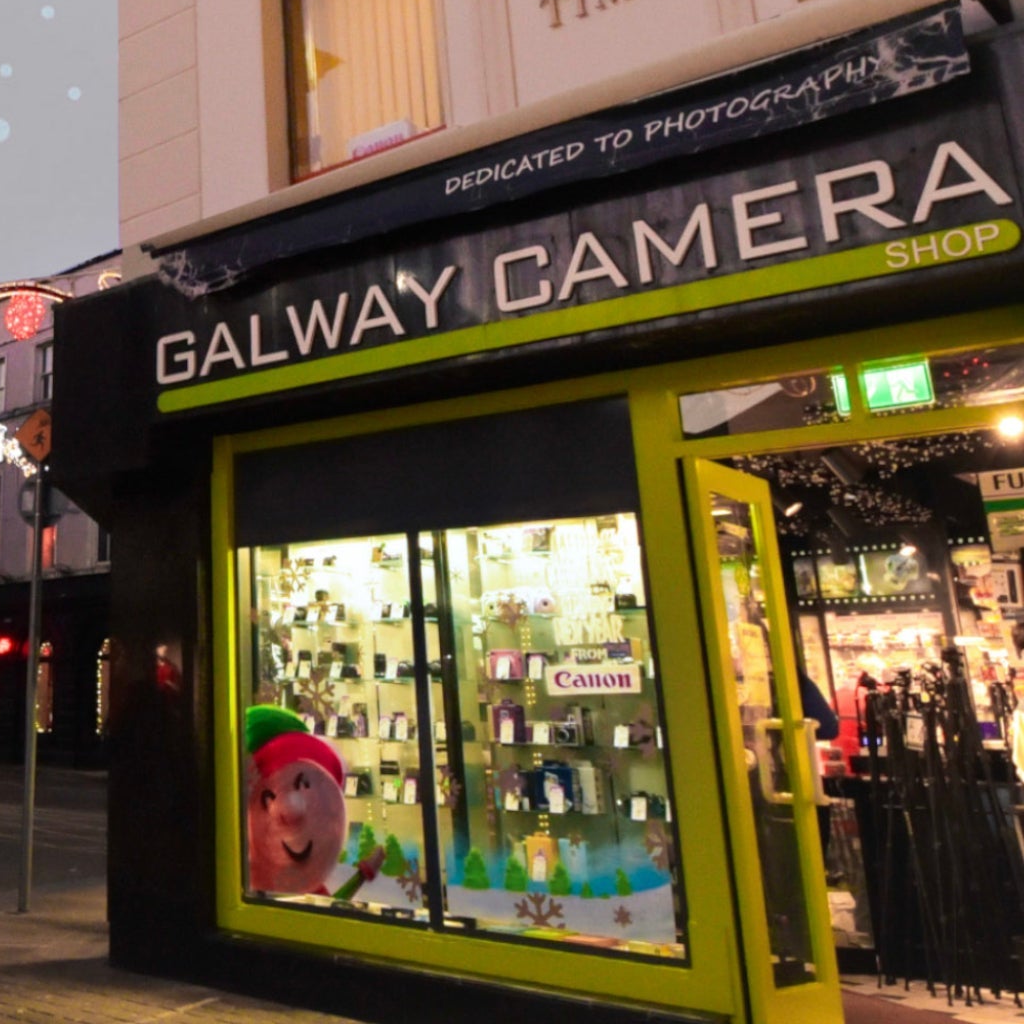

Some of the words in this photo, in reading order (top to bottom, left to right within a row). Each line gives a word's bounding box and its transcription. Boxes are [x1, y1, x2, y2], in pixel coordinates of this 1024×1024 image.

[445, 141, 584, 195] DEDICATED
[594, 129, 633, 152] TO
[644, 54, 885, 142] PHOTOGRAPHY
[156, 264, 458, 385] GALWAY
[492, 141, 1013, 313] CAMERA
[885, 223, 1001, 269] SHOP
[571, 648, 608, 661] FROM
[554, 671, 632, 689] Canon
